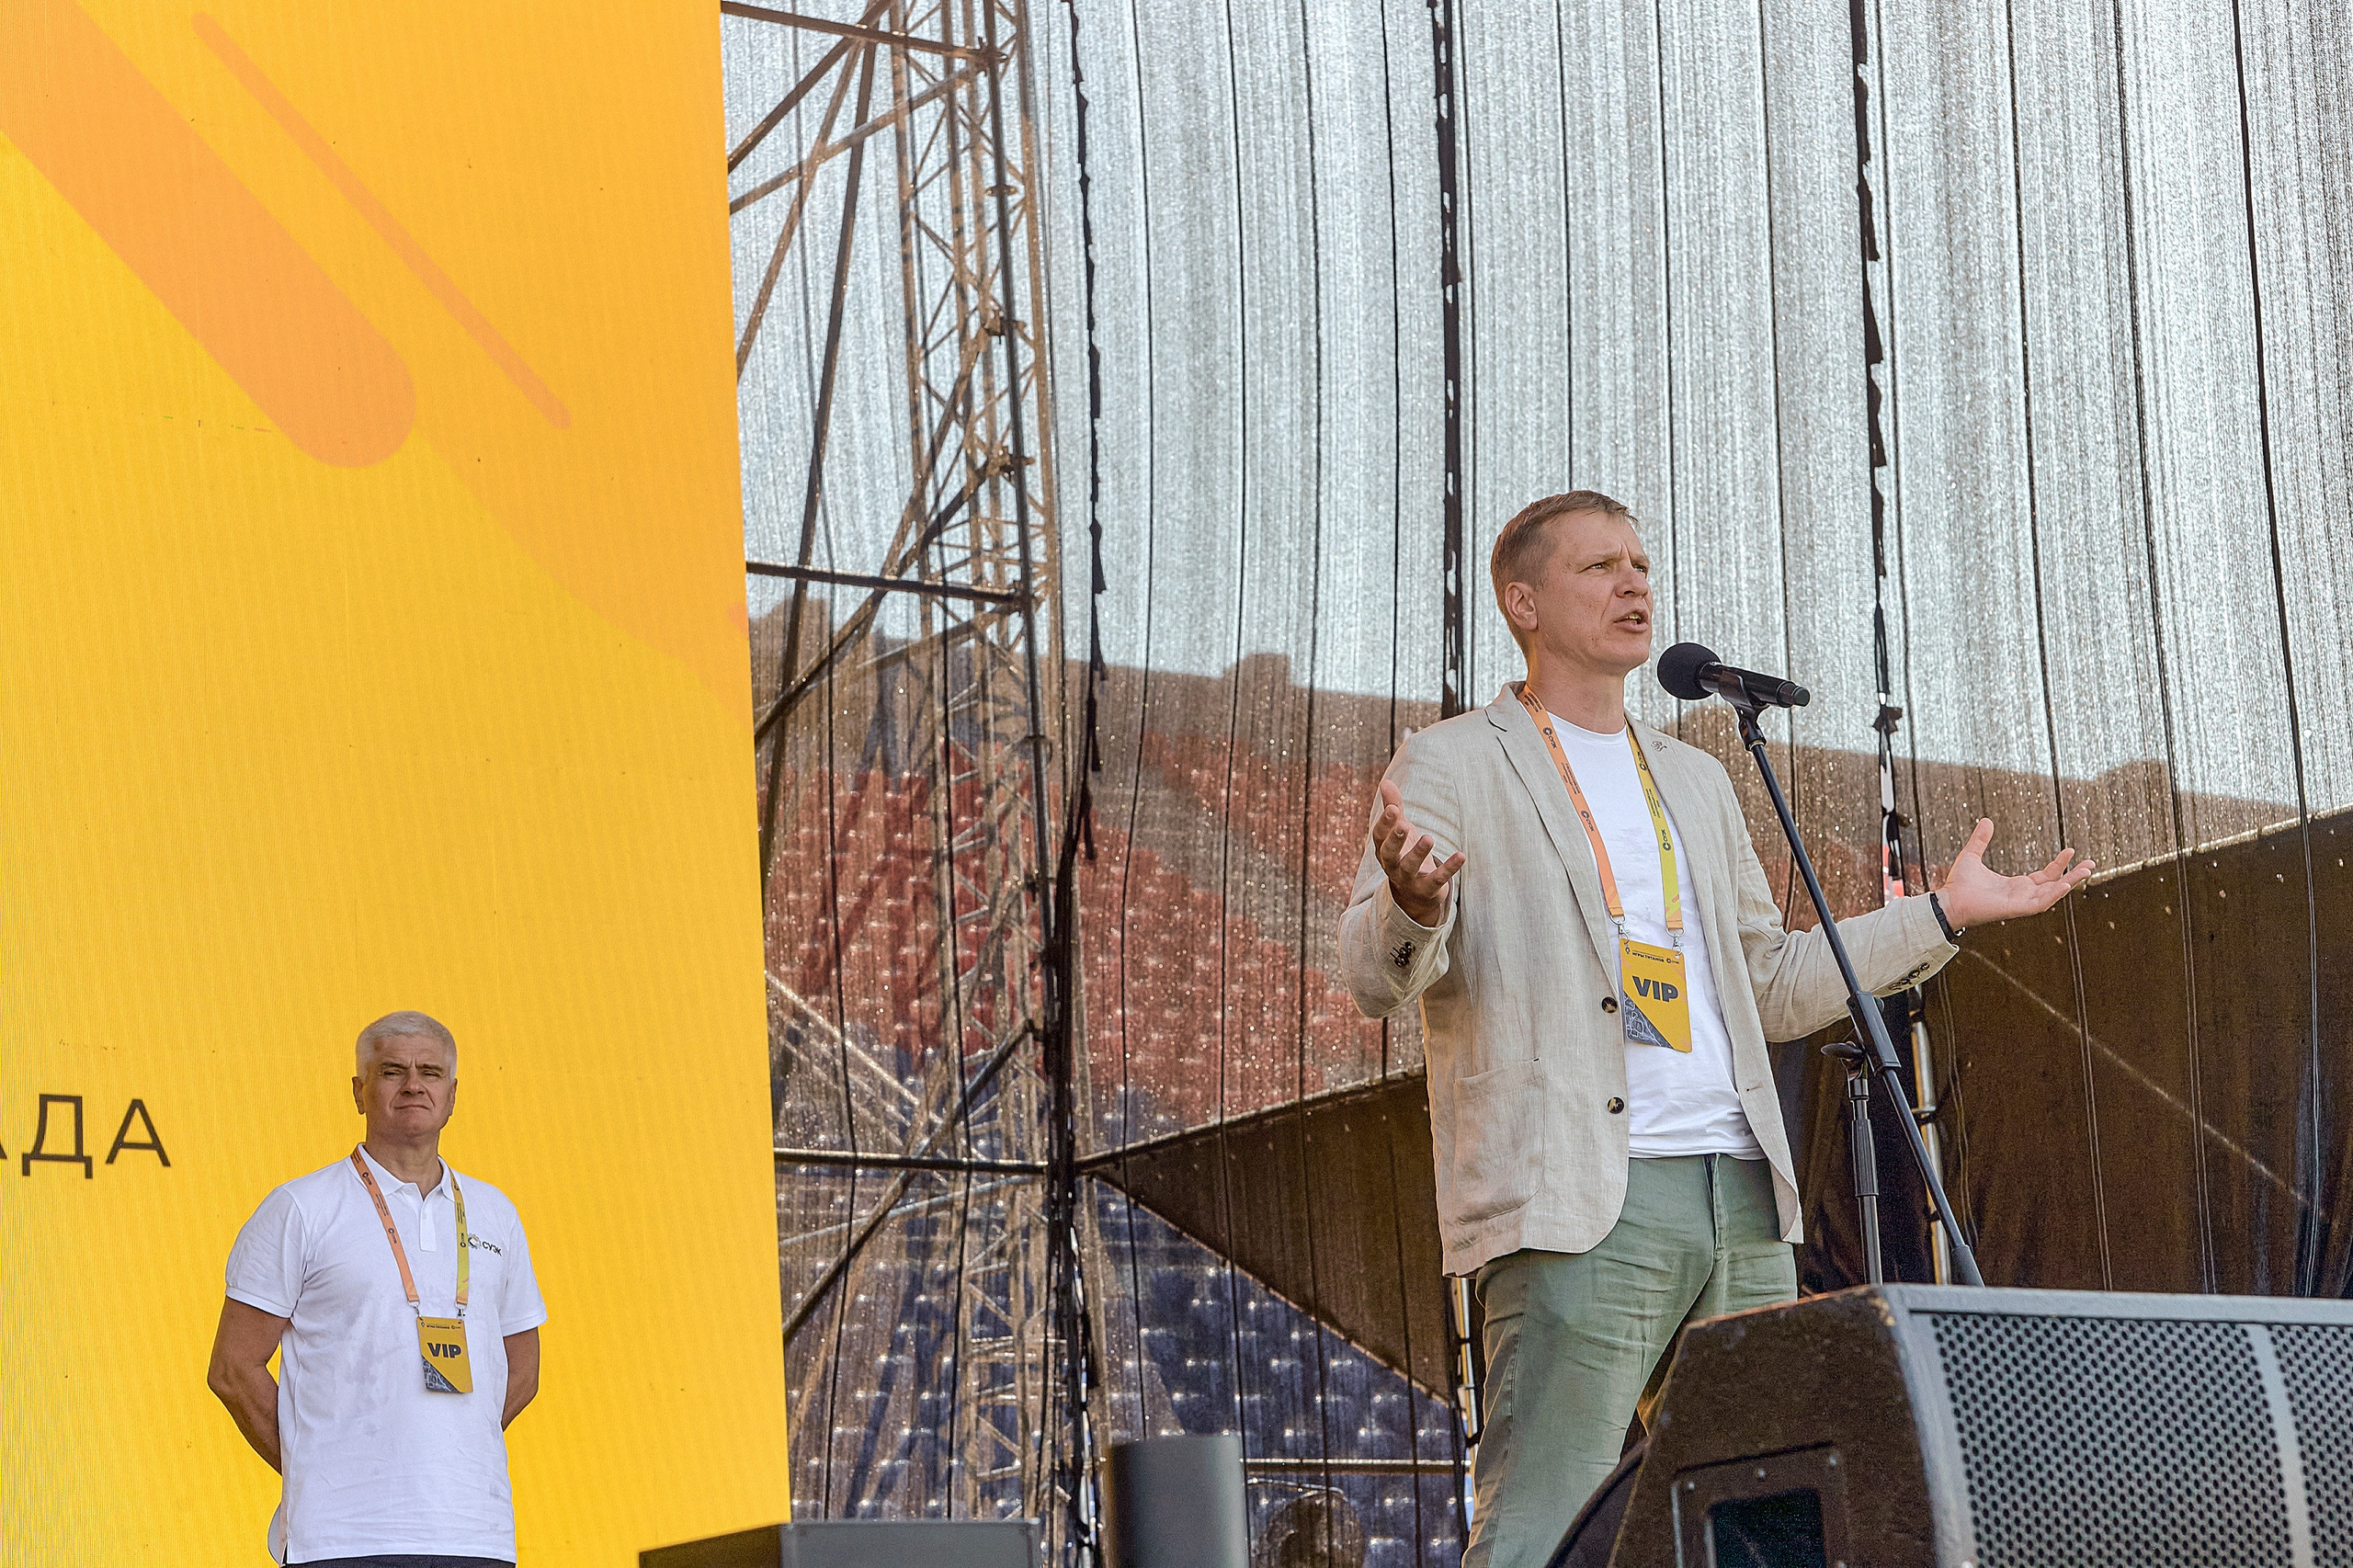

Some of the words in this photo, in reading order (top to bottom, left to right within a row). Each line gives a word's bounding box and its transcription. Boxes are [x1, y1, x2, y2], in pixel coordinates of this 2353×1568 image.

[1548, 735, 1557, 748] СУЭК
[1632, 975, 1678, 1003] VIP
[0, 1094, 171, 1179] ДА
[482, 1241, 503, 1256] СУЭК
[426, 1342, 461, 1358] VIP
